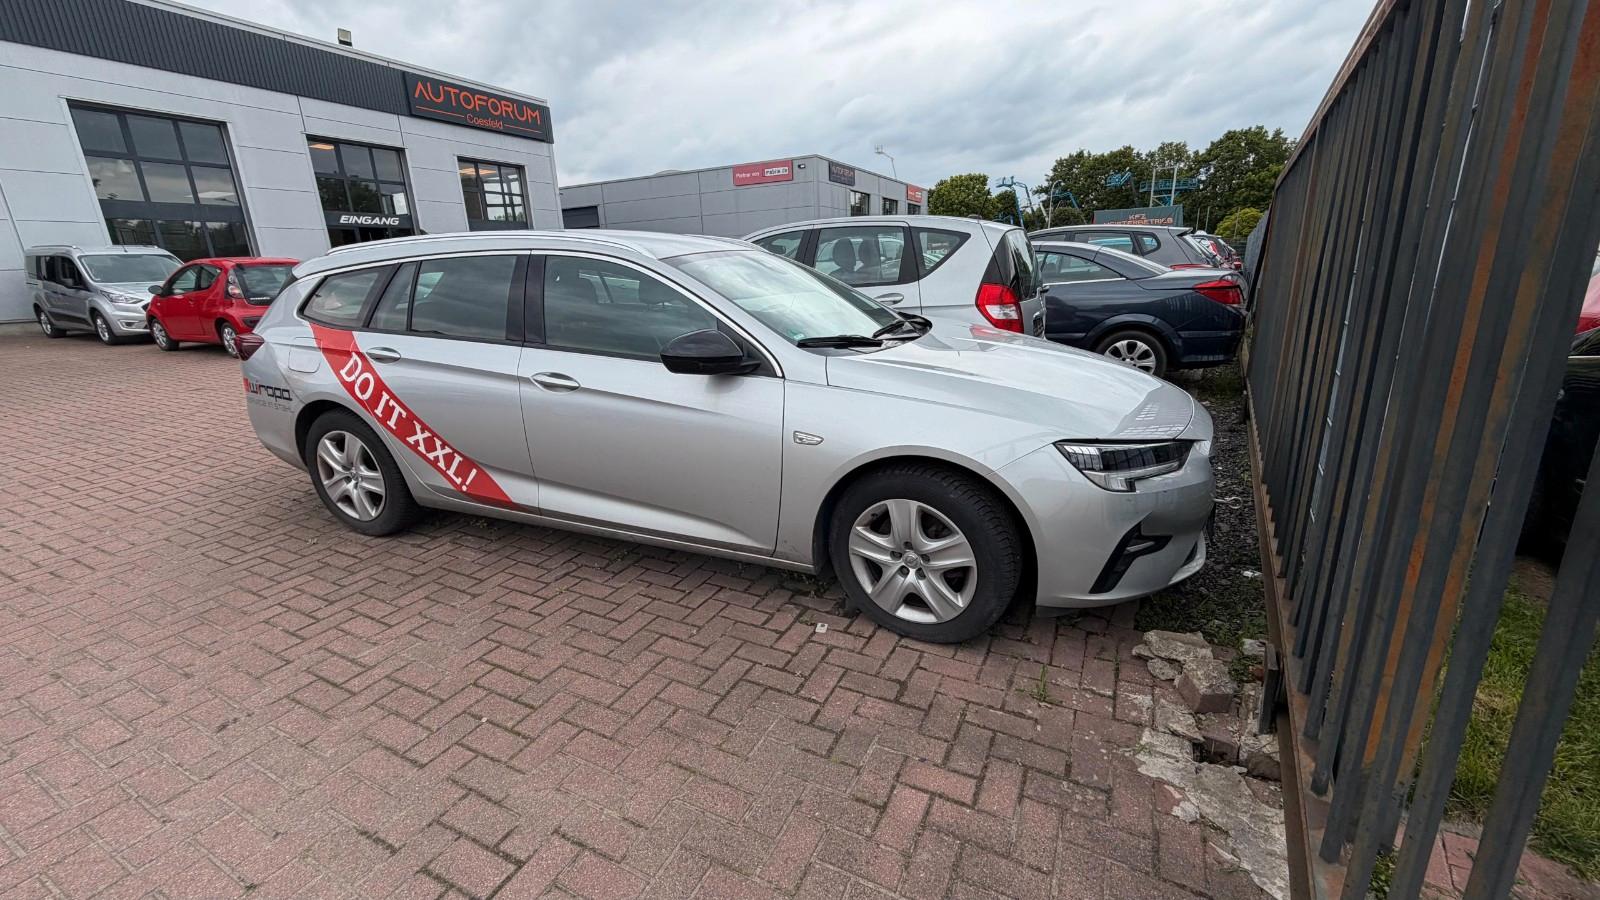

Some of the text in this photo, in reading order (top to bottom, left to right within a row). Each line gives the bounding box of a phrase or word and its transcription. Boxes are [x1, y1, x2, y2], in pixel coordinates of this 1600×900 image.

[414, 81, 540, 125] AUTOFORUM
[466, 113, 503, 129] Coesfeld
[339, 215, 400, 226] EINGANG
[339, 352, 478, 492] DO IT XXL!
